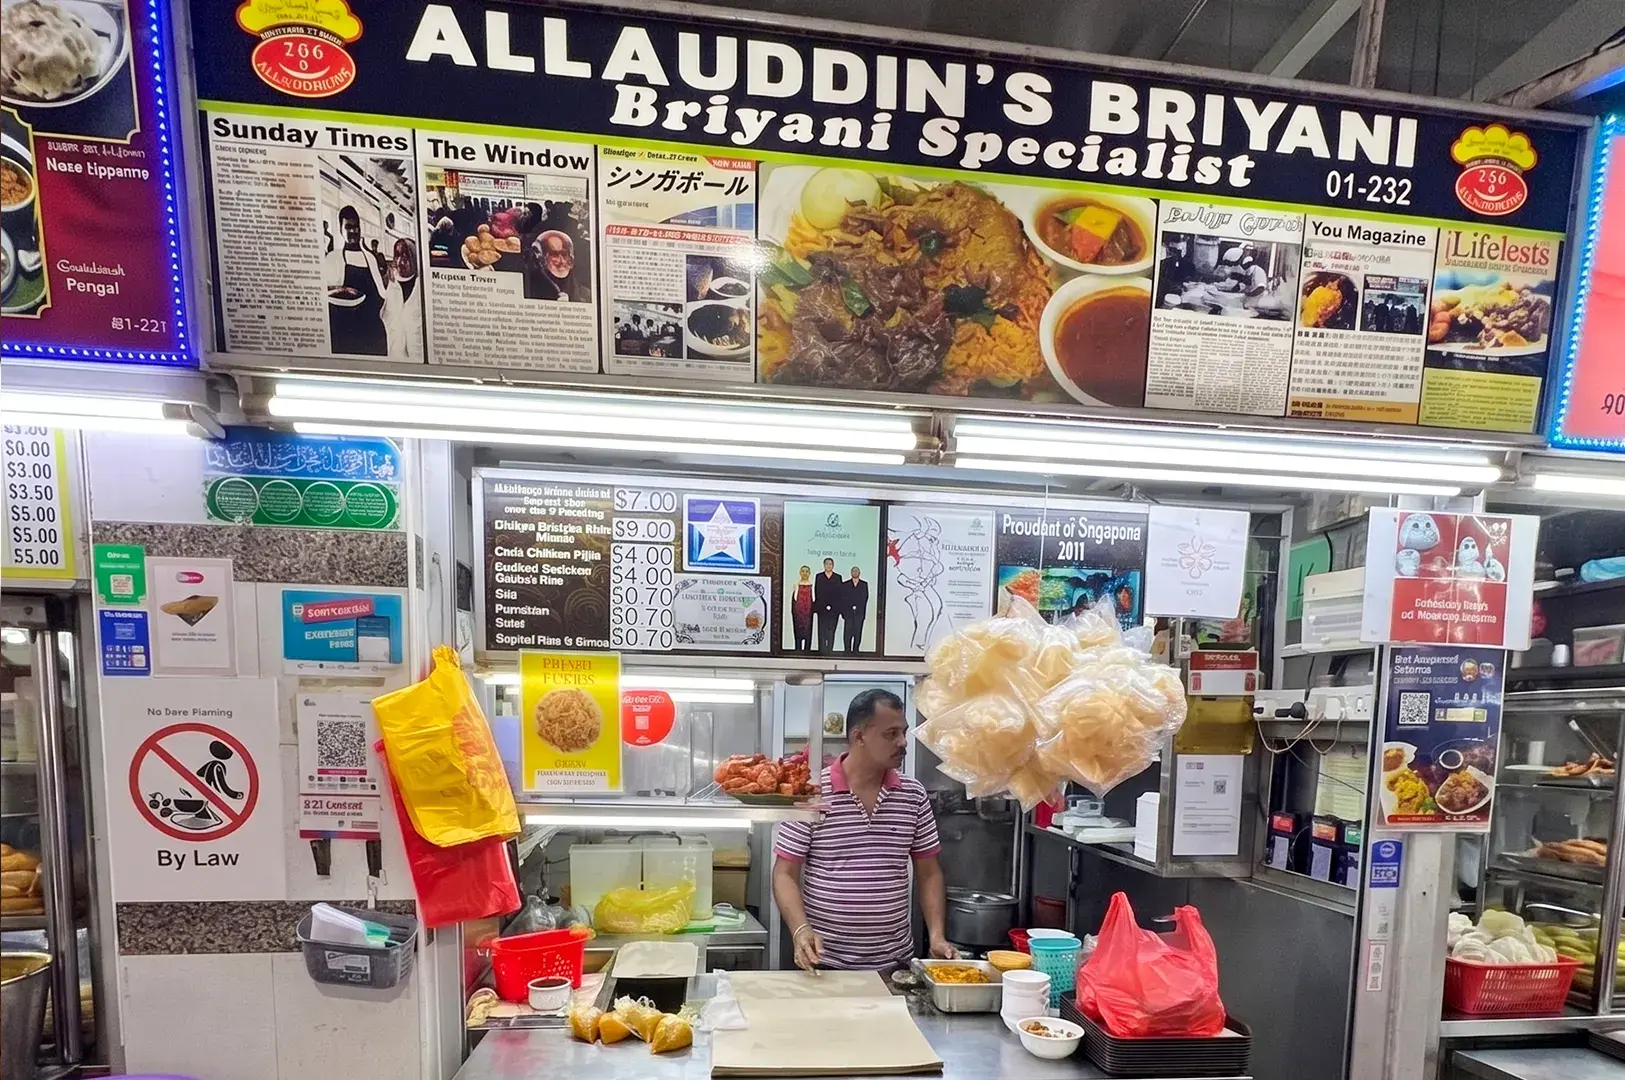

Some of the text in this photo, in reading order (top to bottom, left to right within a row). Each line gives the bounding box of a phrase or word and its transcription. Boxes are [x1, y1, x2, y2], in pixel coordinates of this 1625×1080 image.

[405, 3, 1418, 168] ALLAUDDIN'S BRIYANI
[213, 117, 409, 151] Sunday Times
[609, 84, 1255, 188] Briyani Specialist
[427, 138, 476, 162] The
[484, 143, 590, 171] Window
[1326, 170, 1413, 206] 01-232
[1312, 220, 1342, 238] You
[1348, 224, 1427, 246] Magazine
[67, 278, 119, 297] Pengal
[6, 439, 50, 457] $0.00
[8, 462, 52, 479] $3.00
[9, 483, 53, 501] $3.50
[615, 489, 675, 511] $7.00
[11, 505, 56, 523] $5.00
[13, 526, 57, 544] $5.00
[615, 520, 671, 538] $9.00
[612, 545, 673, 565] $4.00
[1058, 541, 1084, 561] 2011
[612, 566, 673, 585] $4.00
[612, 586, 673, 606] $0.70
[612, 607, 673, 627] $0.70
[612, 628, 673, 648] $0.70
[148, 708, 161, 716] No
[158, 850, 239, 870] By Law
